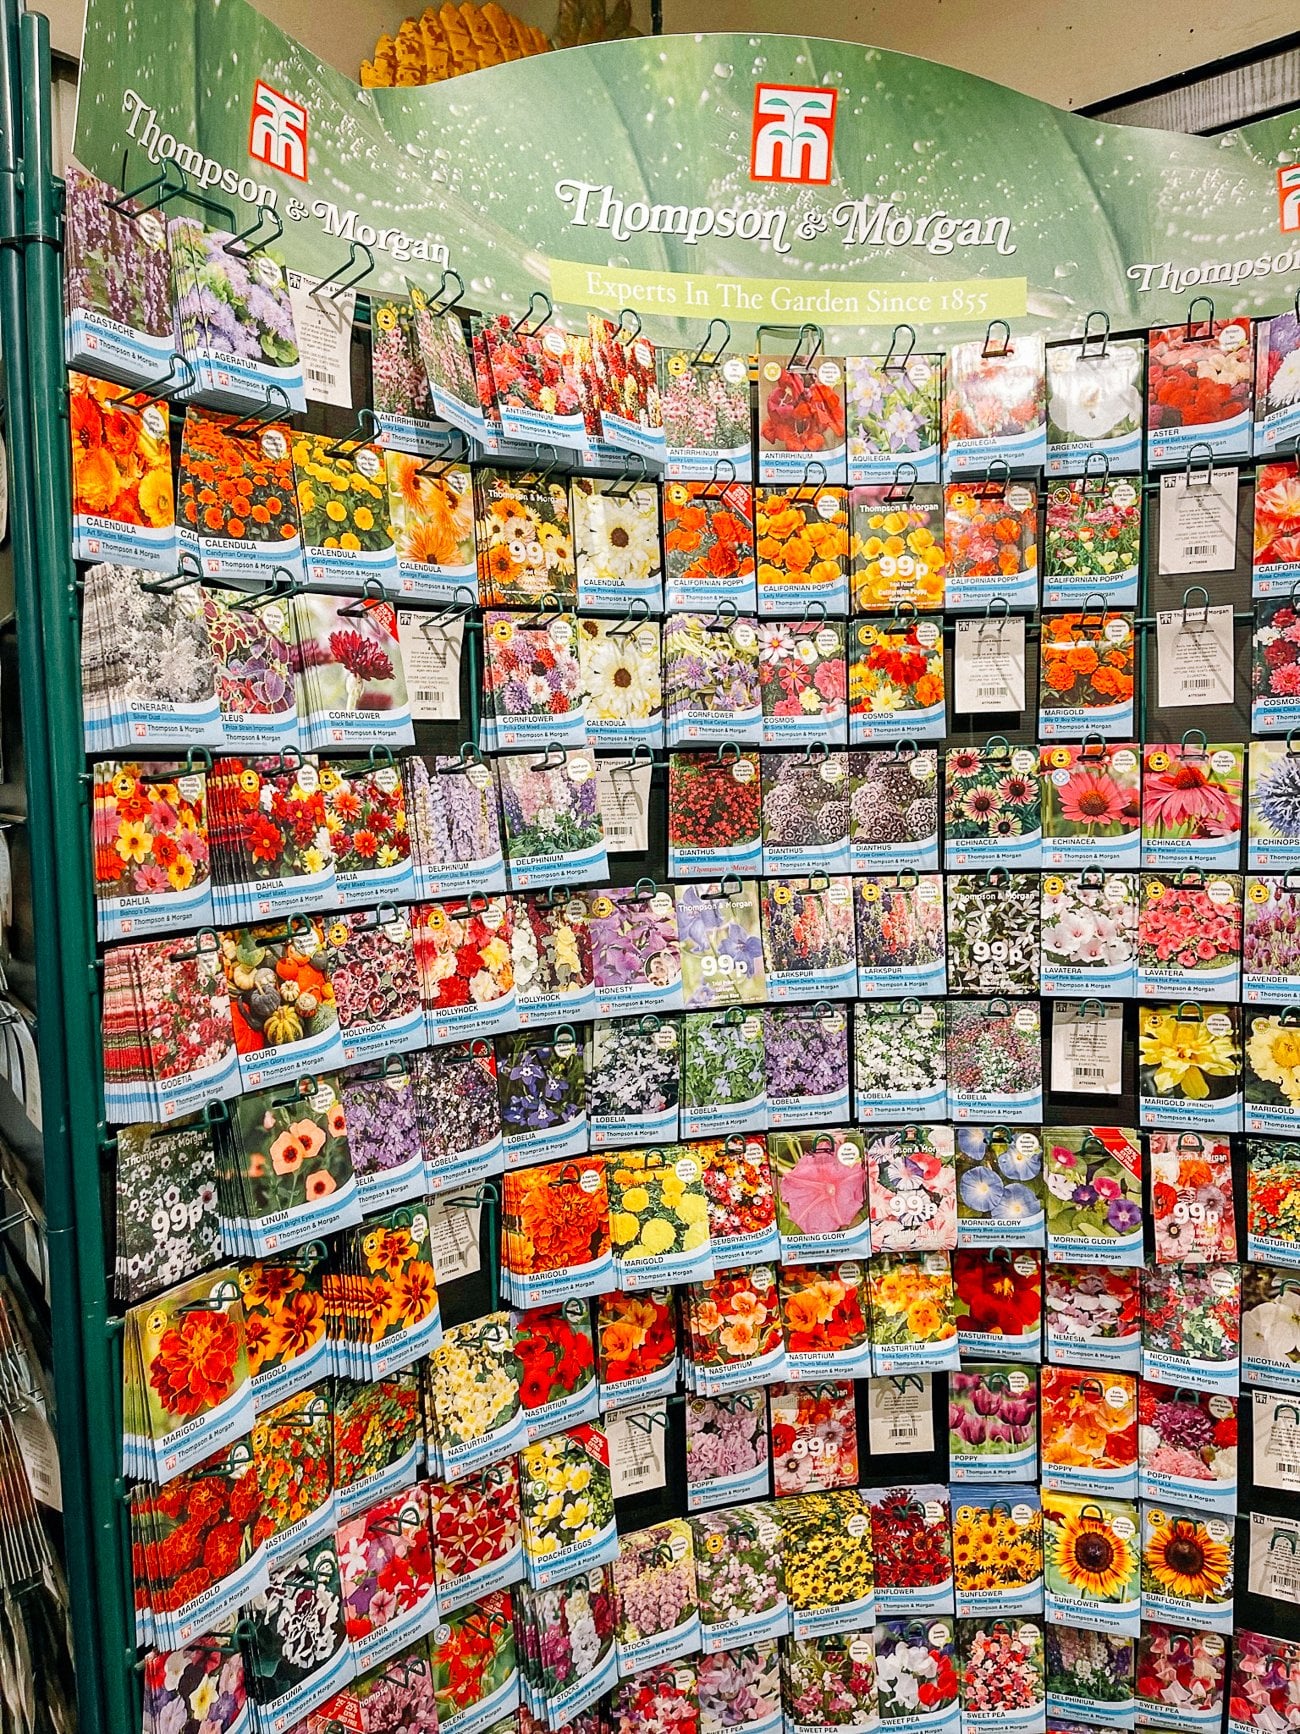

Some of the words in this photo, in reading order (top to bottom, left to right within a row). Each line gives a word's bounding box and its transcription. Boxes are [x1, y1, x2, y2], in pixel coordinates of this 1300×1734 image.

[123, 89, 278, 220] Thompson
[285, 198, 309, 221] &
[311, 200, 451, 271] Morgan
[555, 179, 792, 254] Thompson
[799, 210, 828, 240] &
[832, 200, 1018, 255] Morgan
[586, 272, 676, 305] Experts
[686, 281, 709, 305] In
[716, 283, 763, 309] The
[771, 287, 859, 313] Garden
[867, 288, 931, 312] Since
[940, 288, 988, 315] 1855
[84, 312, 135, 338] AGASTACHE
[215, 351, 258, 370] AGERATUM
[380, 414, 430, 429] ANTIRRHINUM
[1267, 409, 1288, 422] ASTER
[1153, 429, 1179, 437] ASTER
[1050, 442, 1093, 451] ARGEMONE
[86, 517, 136, 534] CALENDULA
[205, 539, 256, 550] CALENDULA
[311, 548, 356, 558] CALENDULA
[508, 540, 557, 568] 99p
[400, 562, 441, 573] CALENDULA
[880, 556, 928, 580] 99p
[583, 579, 625, 587] CALENDULA
[1049, 575, 1097, 584] CALIFORNIAN
[1099, 574, 1124, 582] POPPY
[812, 583, 834, 591] POPPY
[131, 702, 174, 712] CINERARIA
[1264, 698, 1300, 706] COSMOS
[329, 712, 380, 720] CORNFLOWER
[503, 716, 553, 724] CORNFLOWER
[688, 711, 733, 719] CORNFLOWER
[1147, 839, 1191, 847] ECHINACEA
[1257, 838, 1300, 846] ECHINOPS
[516, 855, 564, 865] DELPHINIUM
[428, 863, 469, 872] DELPHINIUM
[336, 873, 358, 882] AHLIA
[256, 881, 283, 890] DAHLIA
[120, 897, 150, 907] DAHLIA
[973, 942, 1023, 964] 99p
[701, 955, 748, 978] 99p
[599, 986, 632, 994] HONESTY
[519, 994, 560, 1003] HOLLYHOCK
[436, 1005, 478, 1016] HOLLYHOCK
[343, 1023, 386, 1038] HOLLYHOCK
[245, 1048, 277, 1062] GOURD
[161, 1074, 192, 1090] GODETIA
[1252, 1105, 1294, 1114] MARIGOLD
[507, 1133, 536, 1143] LOBELIA
[431, 1154, 458, 1168] LOBELIA
[261, 1212, 288, 1226] LINUM
[1173, 1201, 1218, 1226] 99p
[151, 1200, 203, 1241] 99p
[279, 1226, 310, 1240] Thompson
[318, 1215, 340, 1228] Morgan
[787, 1235, 821, 1243] MORNING
[823, 1233, 845, 1241] GLORY
[1054, 1236, 1090, 1244] MORNING
[1091, 1238, 1117, 1246] GLORY
[624, 1257, 664, 1267] MARIGOLD
[529, 1269, 567, 1282] MARIGOLD
[375, 1330, 408, 1351] MARIGOLD
[958, 1332, 1003, 1341] NASTURTIUM
[1053, 1334, 1085, 1343] NEMESIA
[1150, 1353, 1191, 1366] NICOTIANA
[1247, 1356, 1290, 1369] NICOTIANA
[709, 1361, 752, 1375] NASTURTIUM
[606, 1377, 647, 1391] NASTURTIUM
[525, 1399, 567, 1417] NASTURTIUM
[162, 1417, 205, 1446] MARIGOLD
[448, 1433, 493, 1457] NASTURTIUM
[791, 1438, 838, 1459] 99p
[1049, 1464, 1072, 1472] POPPY
[1147, 1471, 1172, 1481] POPPY
[340, 1470, 384, 1497] NASTURTIUM
[691, 1480, 714, 1489] POPPY
[537, 1544, 572, 1564] POACHED
[573, 1539, 592, 1553] EGGS
[440, 1573, 471, 1591] PETUNIA
[178, 1586, 220, 1617] MARIGOLD
[1054, 1596, 1099, 1609] SUNFLOWER
[1146, 1594, 1191, 1607] SUNFLOWER
[798, 1606, 840, 1618] SUNFLOWER
[711, 1620, 739, 1632] STOCKS
[358, 1626, 388, 1648] PETUNIA
[623, 1639, 651, 1653] STOCKS
[272, 1685, 303, 1709] PETUNIA
[556, 1682, 580, 1703] STOCKS
[1051, 1694, 1095, 1706] DELPHINIUM
[1139, 1701, 1165, 1712] SWEET
[1167, 1706, 1180, 1714] PEA
[443, 1712, 466, 1729] SILENE
